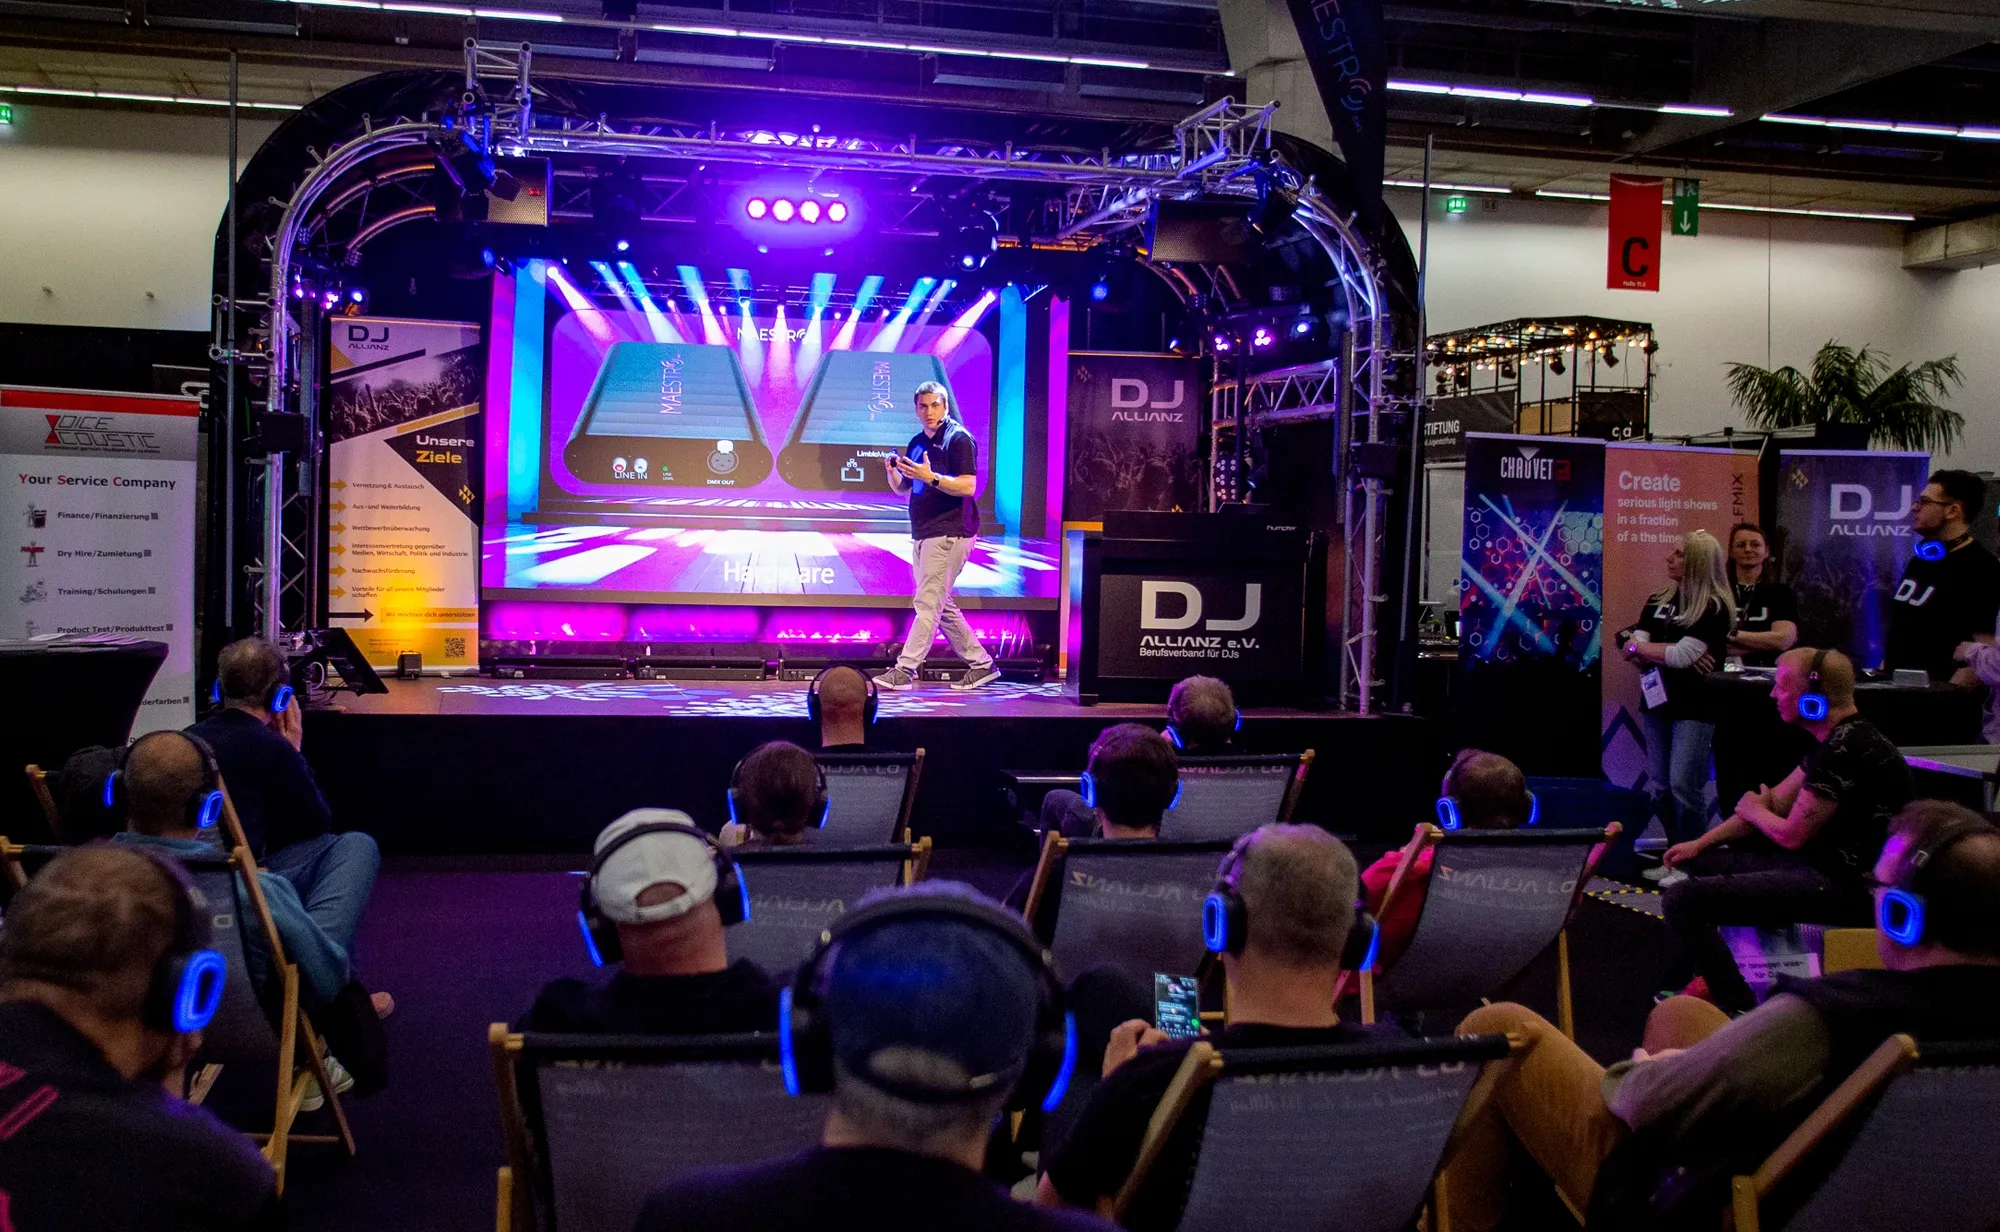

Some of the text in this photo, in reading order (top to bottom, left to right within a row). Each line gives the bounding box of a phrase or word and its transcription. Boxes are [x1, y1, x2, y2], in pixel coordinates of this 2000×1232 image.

[1311, 0, 1372, 111] ESTRO
[1622, 236, 1649, 277] C
[348, 325, 390, 343] DJ
[348, 343, 389, 351] ALLIANZ
[1111, 378, 1184, 410] DJ
[1111, 411, 1184, 423] ALLIANZ
[416, 435, 475, 447] Unsere
[416, 450, 462, 464] Ziele
[1500, 456, 1554, 480] CHAUVET
[19, 473, 176, 491] Your Service Company
[614, 472, 648, 480] LINE IN
[1618, 471, 1681, 492] Create
[352, 482, 388, 490] Vernetzung
[380, 503, 421, 511] Weiterbildung
[1617, 497, 1717, 511] serious light shows
[1830, 483, 1912, 521] DJ
[57, 512, 150, 522] Finance/Finanzierung
[1617, 513, 1678, 526] in a fraction
[352, 525, 430, 533] Wettbewerbsüberwachung
[1829, 524, 1912, 537] ALLIANZ
[1617, 530, 1629, 542] of
[1630, 533, 1638, 542] a
[1640, 531, 1657, 543] the
[57, 550, 143, 559] Dry Hire/Zumietung
[352, 567, 416, 575] Nachwuchsförderung
[57, 588, 147, 597] Training/Schulungen
[1894, 579, 1935, 607] DJ
[1140, 580, 1262, 631] DJ
[57, 625, 165, 634] Product Test/Produkttest
[1140, 635, 1260, 649] ALLIANZ e.V.
[1139, 647, 1239, 659] Berufsverband für DJs
[142, 698, 182, 706] derfarben
